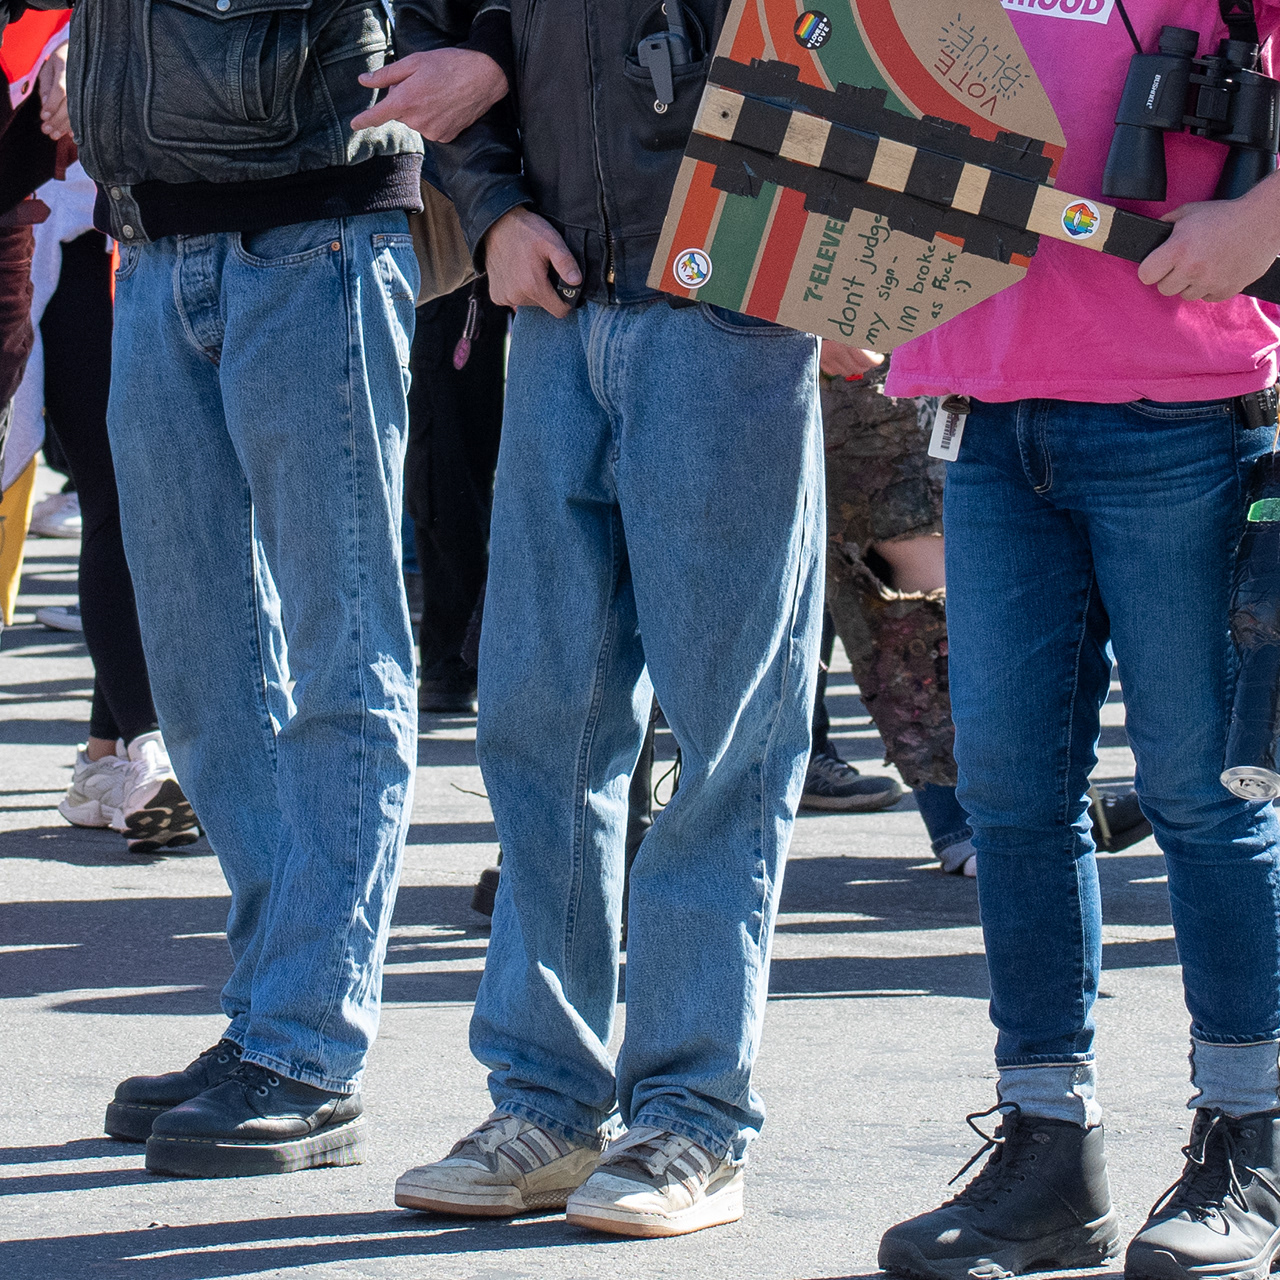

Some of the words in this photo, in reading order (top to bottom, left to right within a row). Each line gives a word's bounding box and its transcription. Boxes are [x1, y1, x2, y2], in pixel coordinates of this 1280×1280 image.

[809, 27, 821, 44] LOVE
[814, 26, 830, 47] LOVE
[950, 26, 1022, 91] BLUE
[934, 49, 997, 116] VOTE
[827, 276, 865, 337] don't
[854, 215, 891, 275] judge
[906, 244, 937, 295] broke
[866, 312, 891, 345] my
[931, 301, 944, 319] as
